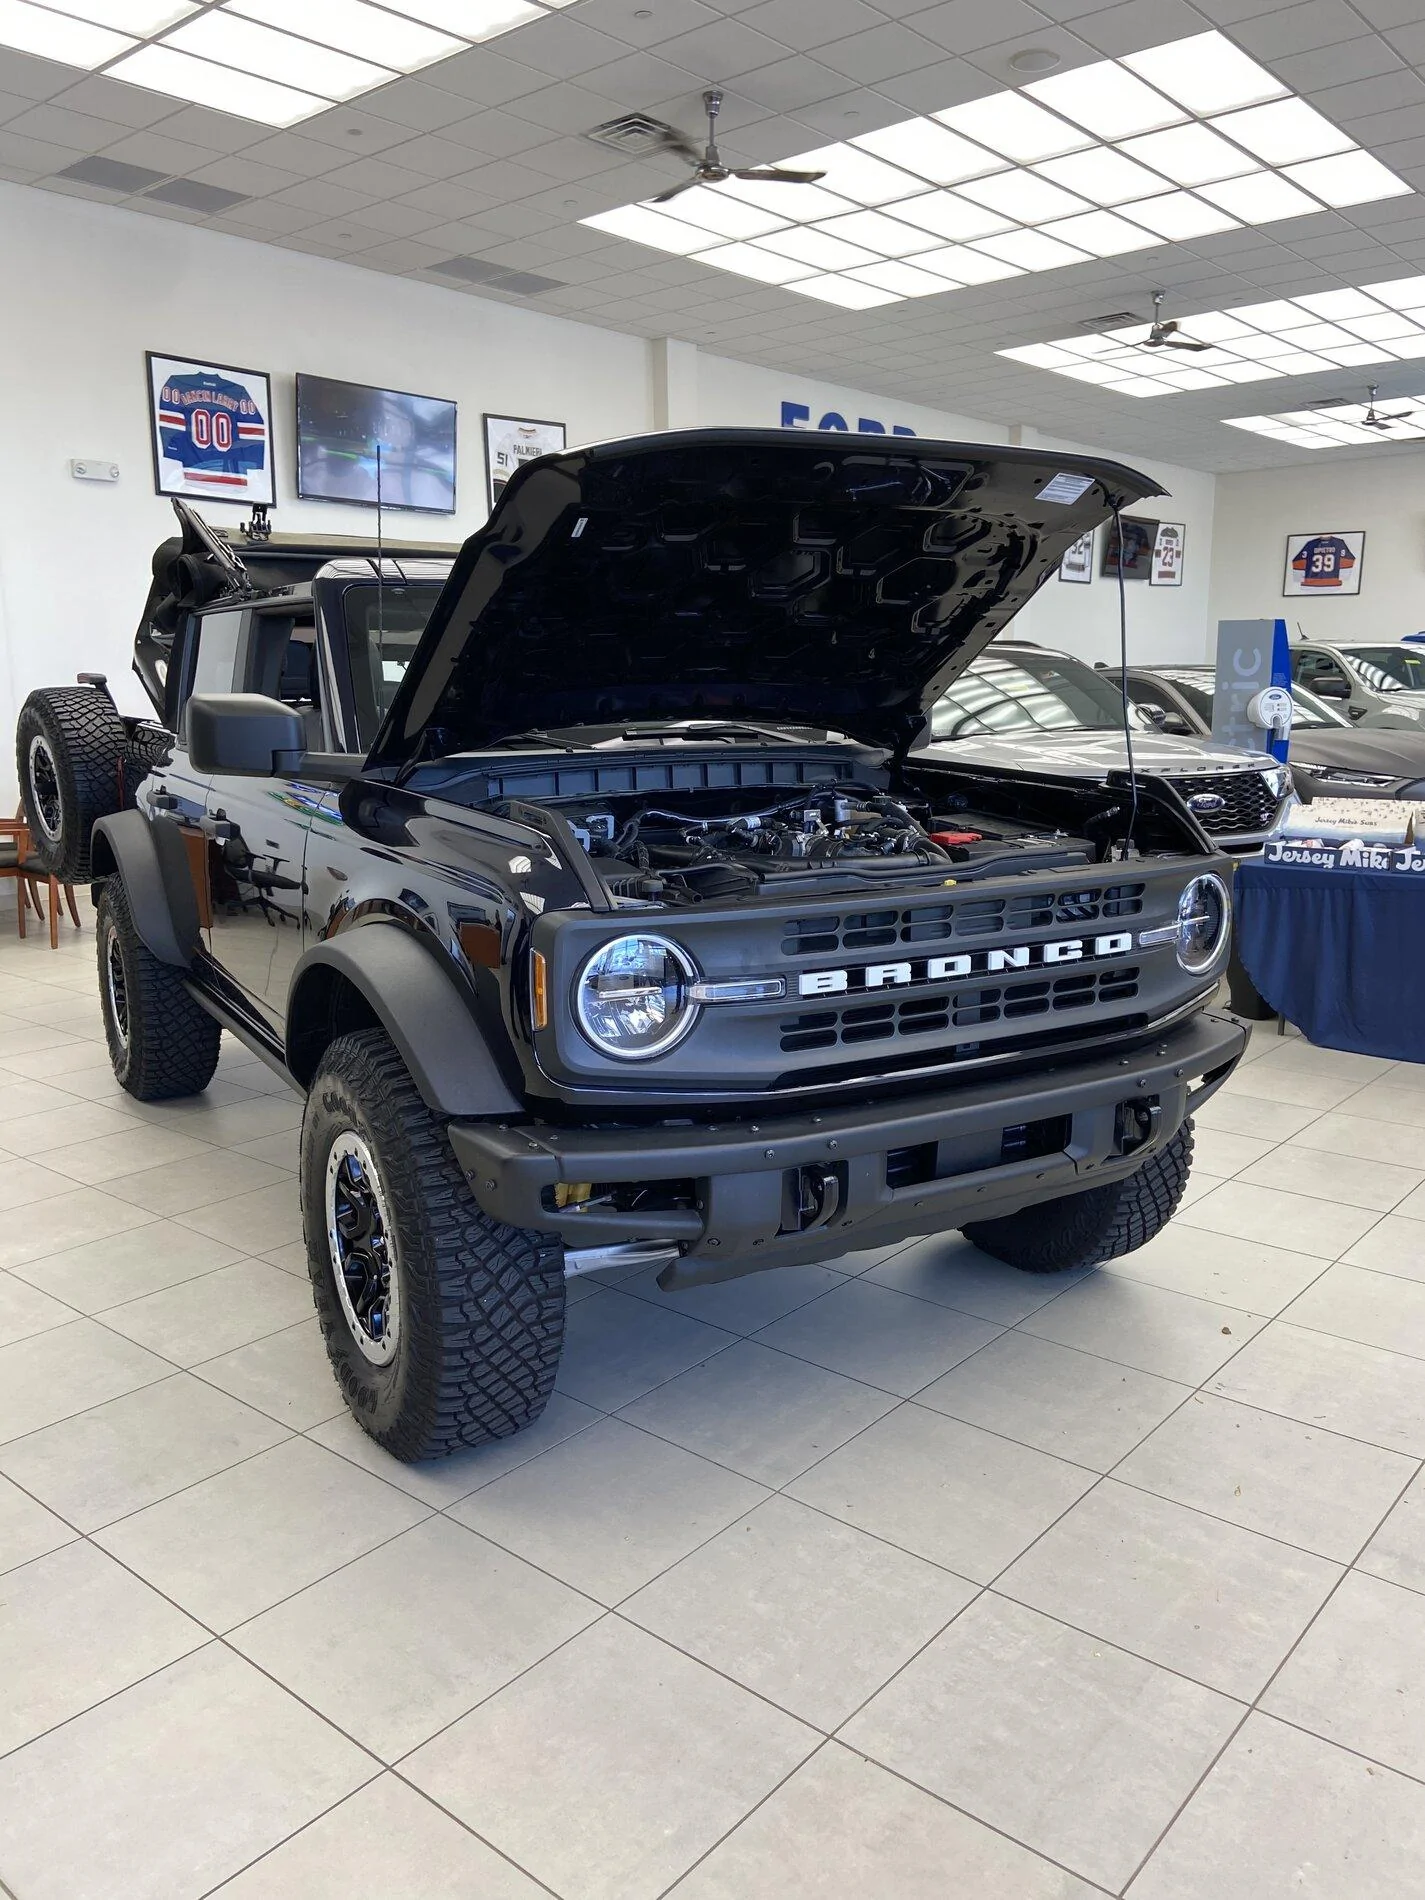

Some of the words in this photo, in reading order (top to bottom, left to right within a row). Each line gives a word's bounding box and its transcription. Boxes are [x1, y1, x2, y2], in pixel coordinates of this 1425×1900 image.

[191, 408, 232, 452] 00
[497, 452, 508, 467] 51
[1162, 546, 1174, 567] 23
[1312, 554, 1335, 572] 39
[1141, 763, 1255, 774] XPLORER
[1268, 841, 1335, 869] Jersey
[799, 932, 1132, 996] BRONCO
